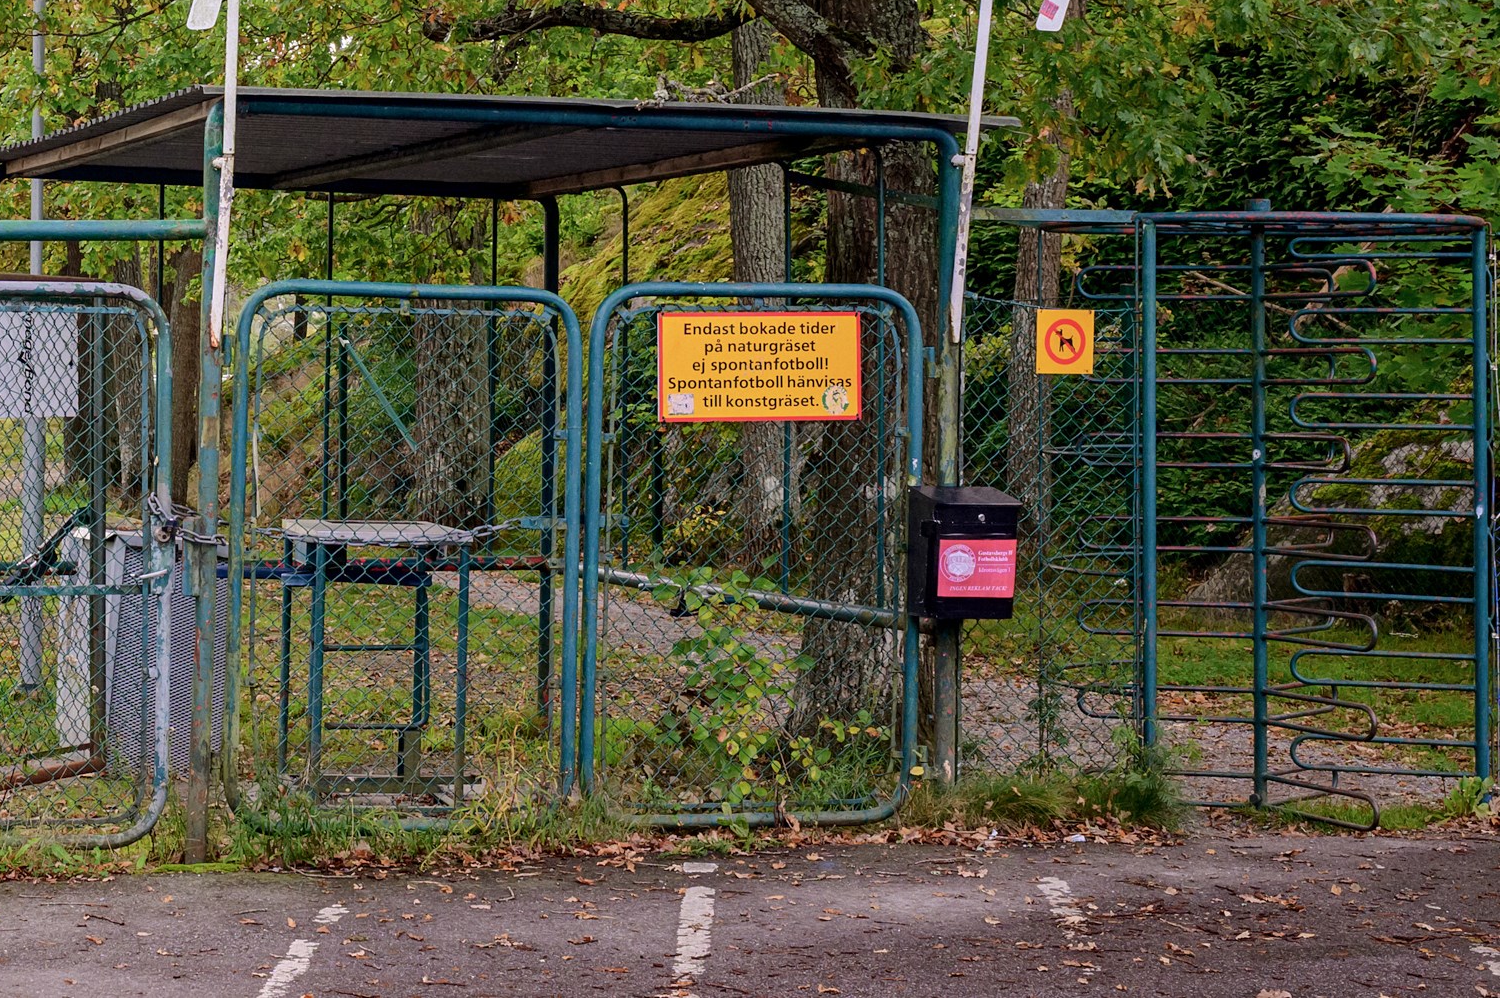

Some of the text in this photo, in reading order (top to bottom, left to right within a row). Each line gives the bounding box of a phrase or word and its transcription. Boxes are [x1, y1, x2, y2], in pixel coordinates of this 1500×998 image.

[684, 322, 836, 335] Endast bokade tider
[704, 339, 816, 355] på naturgräset
[692, 357, 829, 373] ej spontanfotboll!
[668, 375, 852, 392] Spontanfotboll hänvisas
[703, 395, 722, 407] till
[726, 394, 819, 410] konstgräset.
